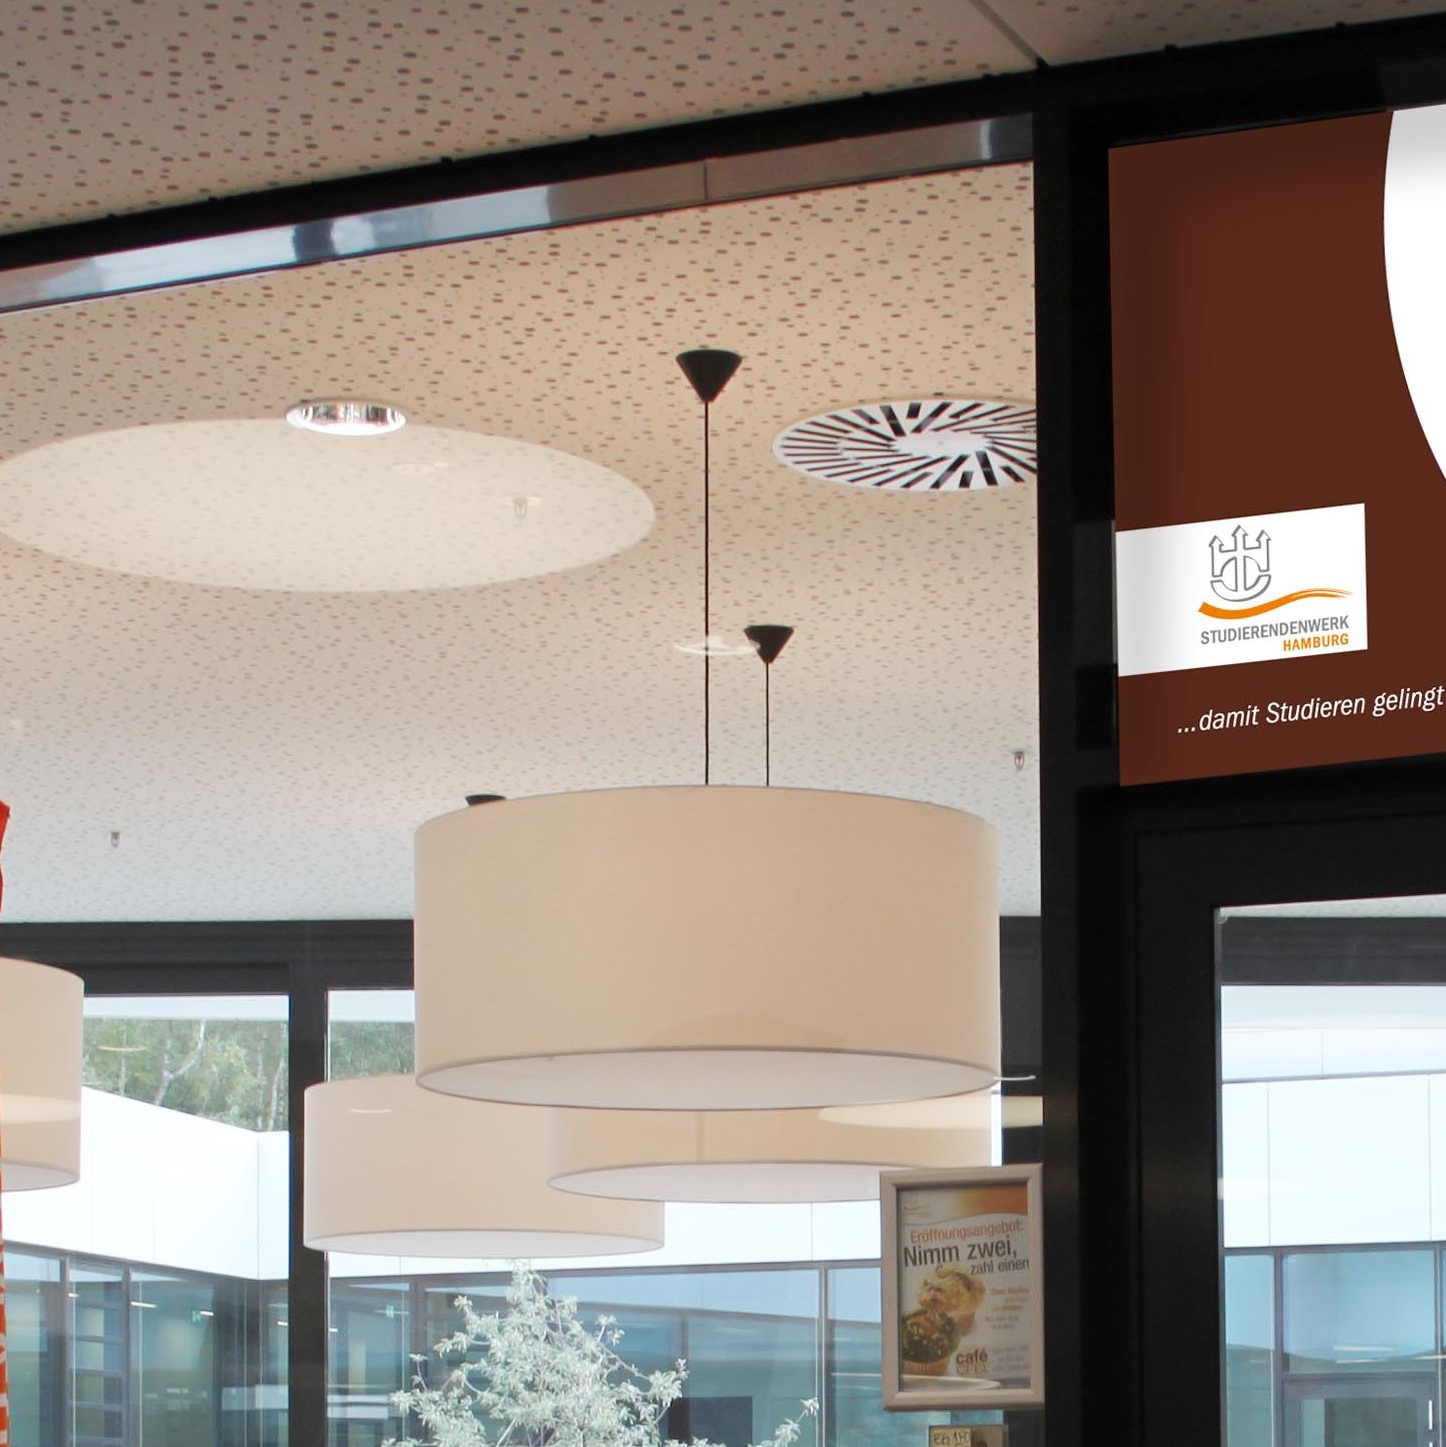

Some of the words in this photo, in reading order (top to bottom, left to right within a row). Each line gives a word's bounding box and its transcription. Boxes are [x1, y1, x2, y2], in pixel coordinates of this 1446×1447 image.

[1200, 615, 1350, 645] STUDIERENDENWERK
[1283, 633, 1350, 652] HAMBURG
[1177, 705, 1260, 734] ...damit
[1266, 696, 1366, 725] Studieren
[910, 1219, 1024, 1245] Eröffnungsangebot:
[903, 1245, 960, 1267] Nimm
[967, 1235, 1017, 1260] zwei,
[970, 1261, 994, 1275] zahl
[998, 1258, 1030, 1273] einen
